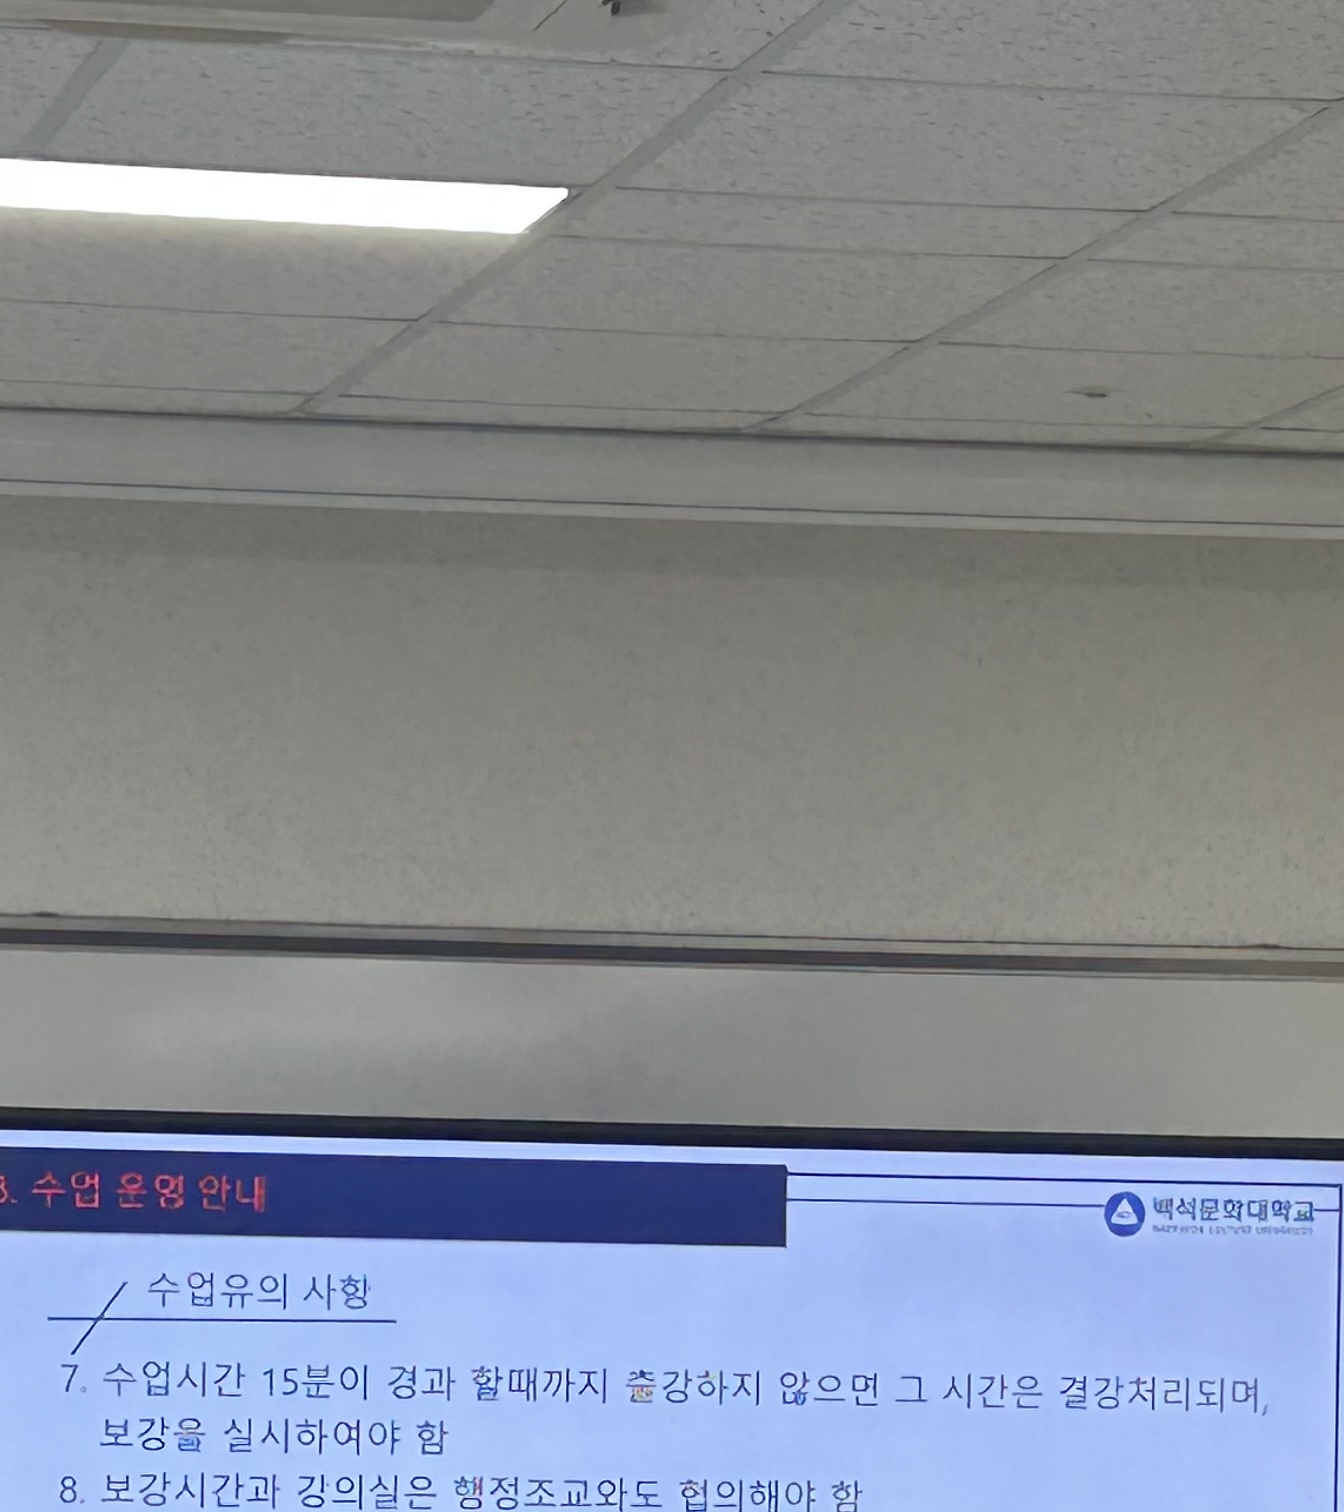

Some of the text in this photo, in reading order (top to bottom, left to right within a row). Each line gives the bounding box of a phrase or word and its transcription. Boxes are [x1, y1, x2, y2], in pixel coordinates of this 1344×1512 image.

[31, 1171, 100, 1208] 수업
[115, 1172, 185, 1210] 운영
[198, 1174, 266, 1213] 안내
[147, 1271, 371, 1311] 수업유의 사항
[60, 1360, 1268, 1416] 7. 수업시간 15분이 경과 할때까지 출강하지 않으면 그 시간은 결강처리되며,
[99, 1416, 449, 1457] 보강을 실시하여야 함
[100, 1471, 281, 1510] 보강시간과
[297, 1473, 438, 1511] 강의실은
[453, 1475, 663, 1512] 행정조교와도
